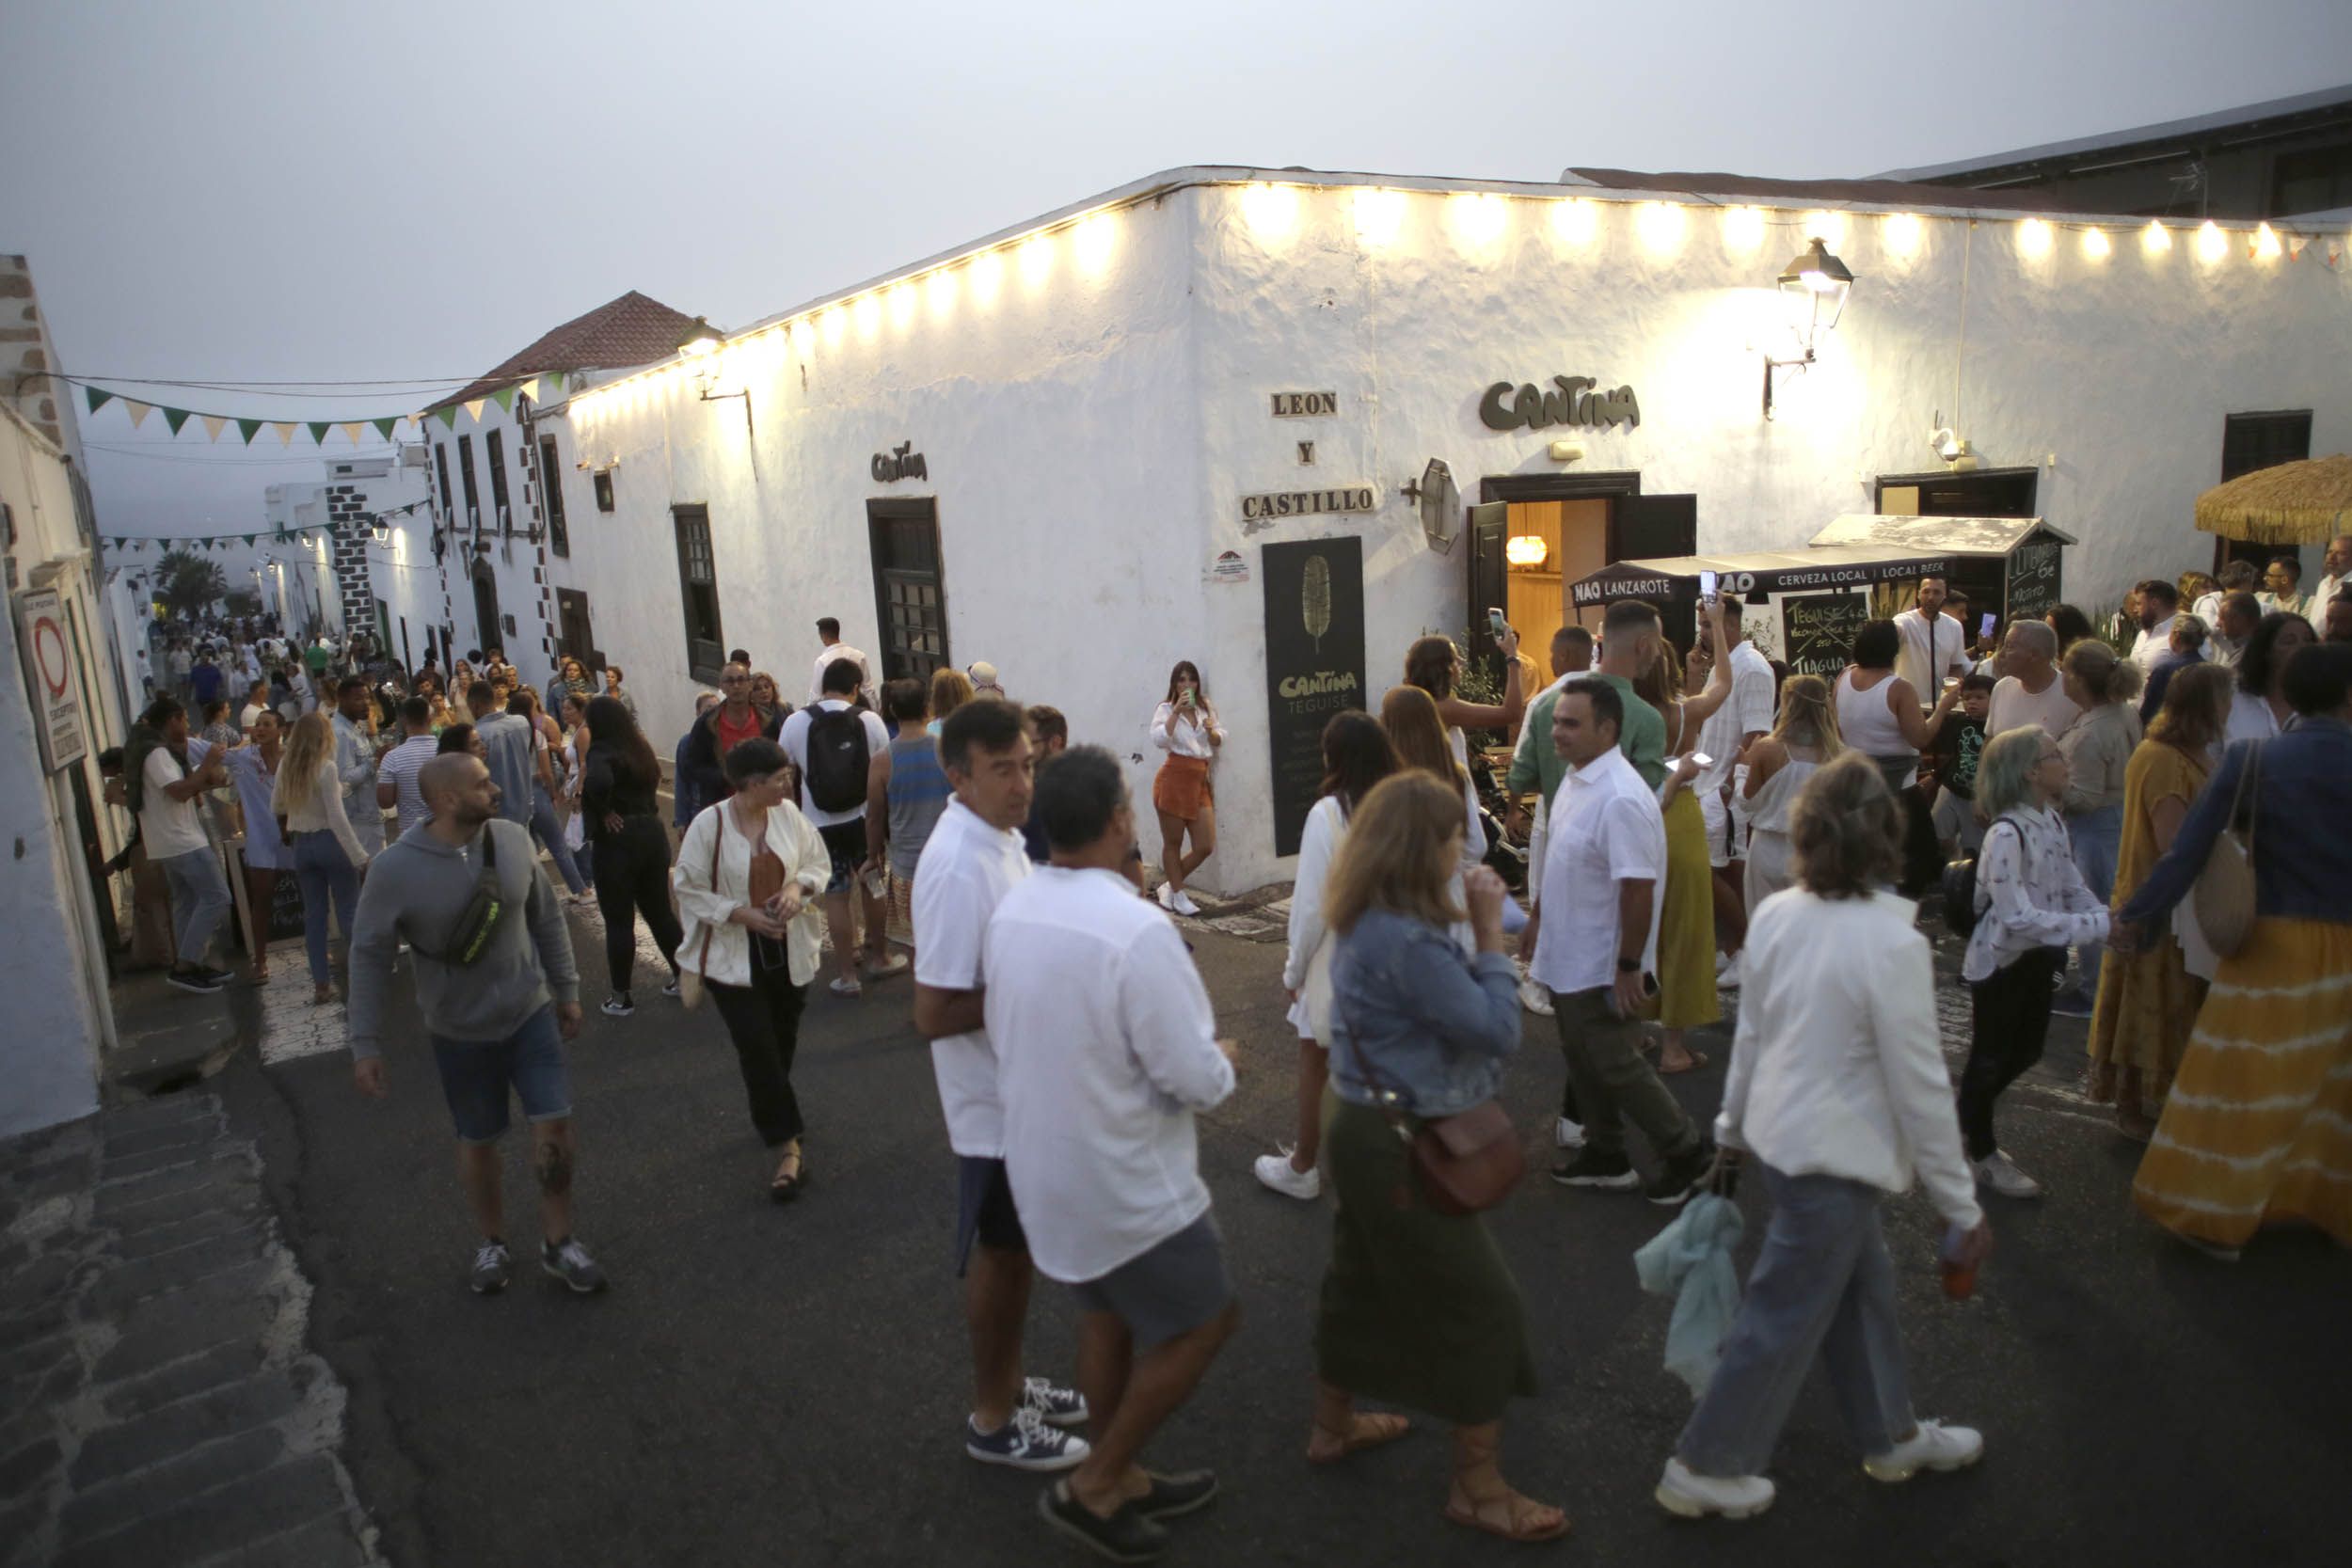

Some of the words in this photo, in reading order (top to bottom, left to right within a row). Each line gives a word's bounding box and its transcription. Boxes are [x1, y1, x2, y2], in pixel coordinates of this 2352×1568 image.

[1272, 393, 1336, 415] LEON
[1298, 442, 1313, 463] Y
[1243, 489, 1372, 517] CASTILLO
[1717, 572, 1755, 594] AO
[1778, 572, 1828, 585] CERVEZA
[1831, 570, 1867, 582] LOCAL
[1883, 564, 1916, 578] LOCAL
[1921, 562, 1944, 573] BEER
[1575, 581, 1600, 602] NAO
[1604, 579, 1670, 595] LANZAROTE
[1791, 656, 1845, 675] TIAGUA
[1287, 694, 1348, 715] TEGUISE
